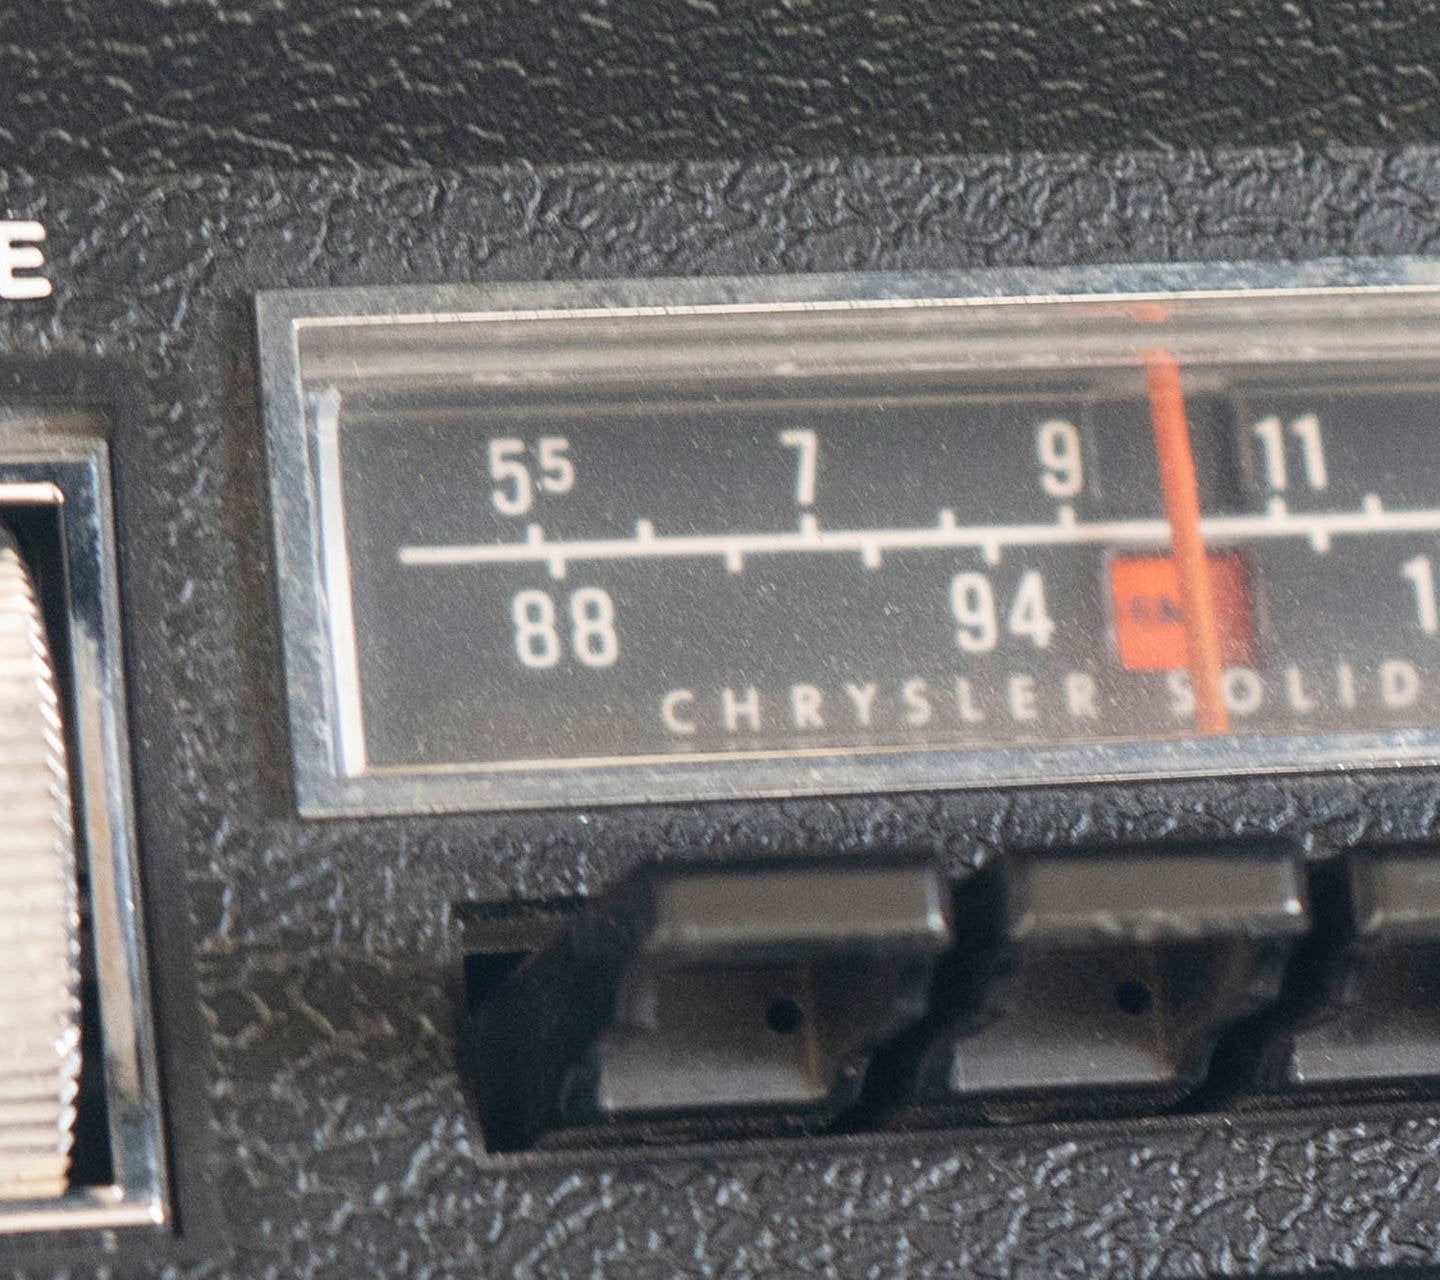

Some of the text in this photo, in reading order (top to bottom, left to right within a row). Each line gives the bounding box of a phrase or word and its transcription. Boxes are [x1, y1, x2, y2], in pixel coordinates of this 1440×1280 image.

[488, 435, 575, 518] 55
[779, 429, 818, 506] 7
[1035, 419, 1084, 498] 9
[1253, 414, 1329, 490] 11
[510, 587, 620, 668] 88
[950, 571, 1056, 654] 94
[660, 672, 1102, 738] CHRYSLER
[1168, 654, 1420, 717] SOLID
